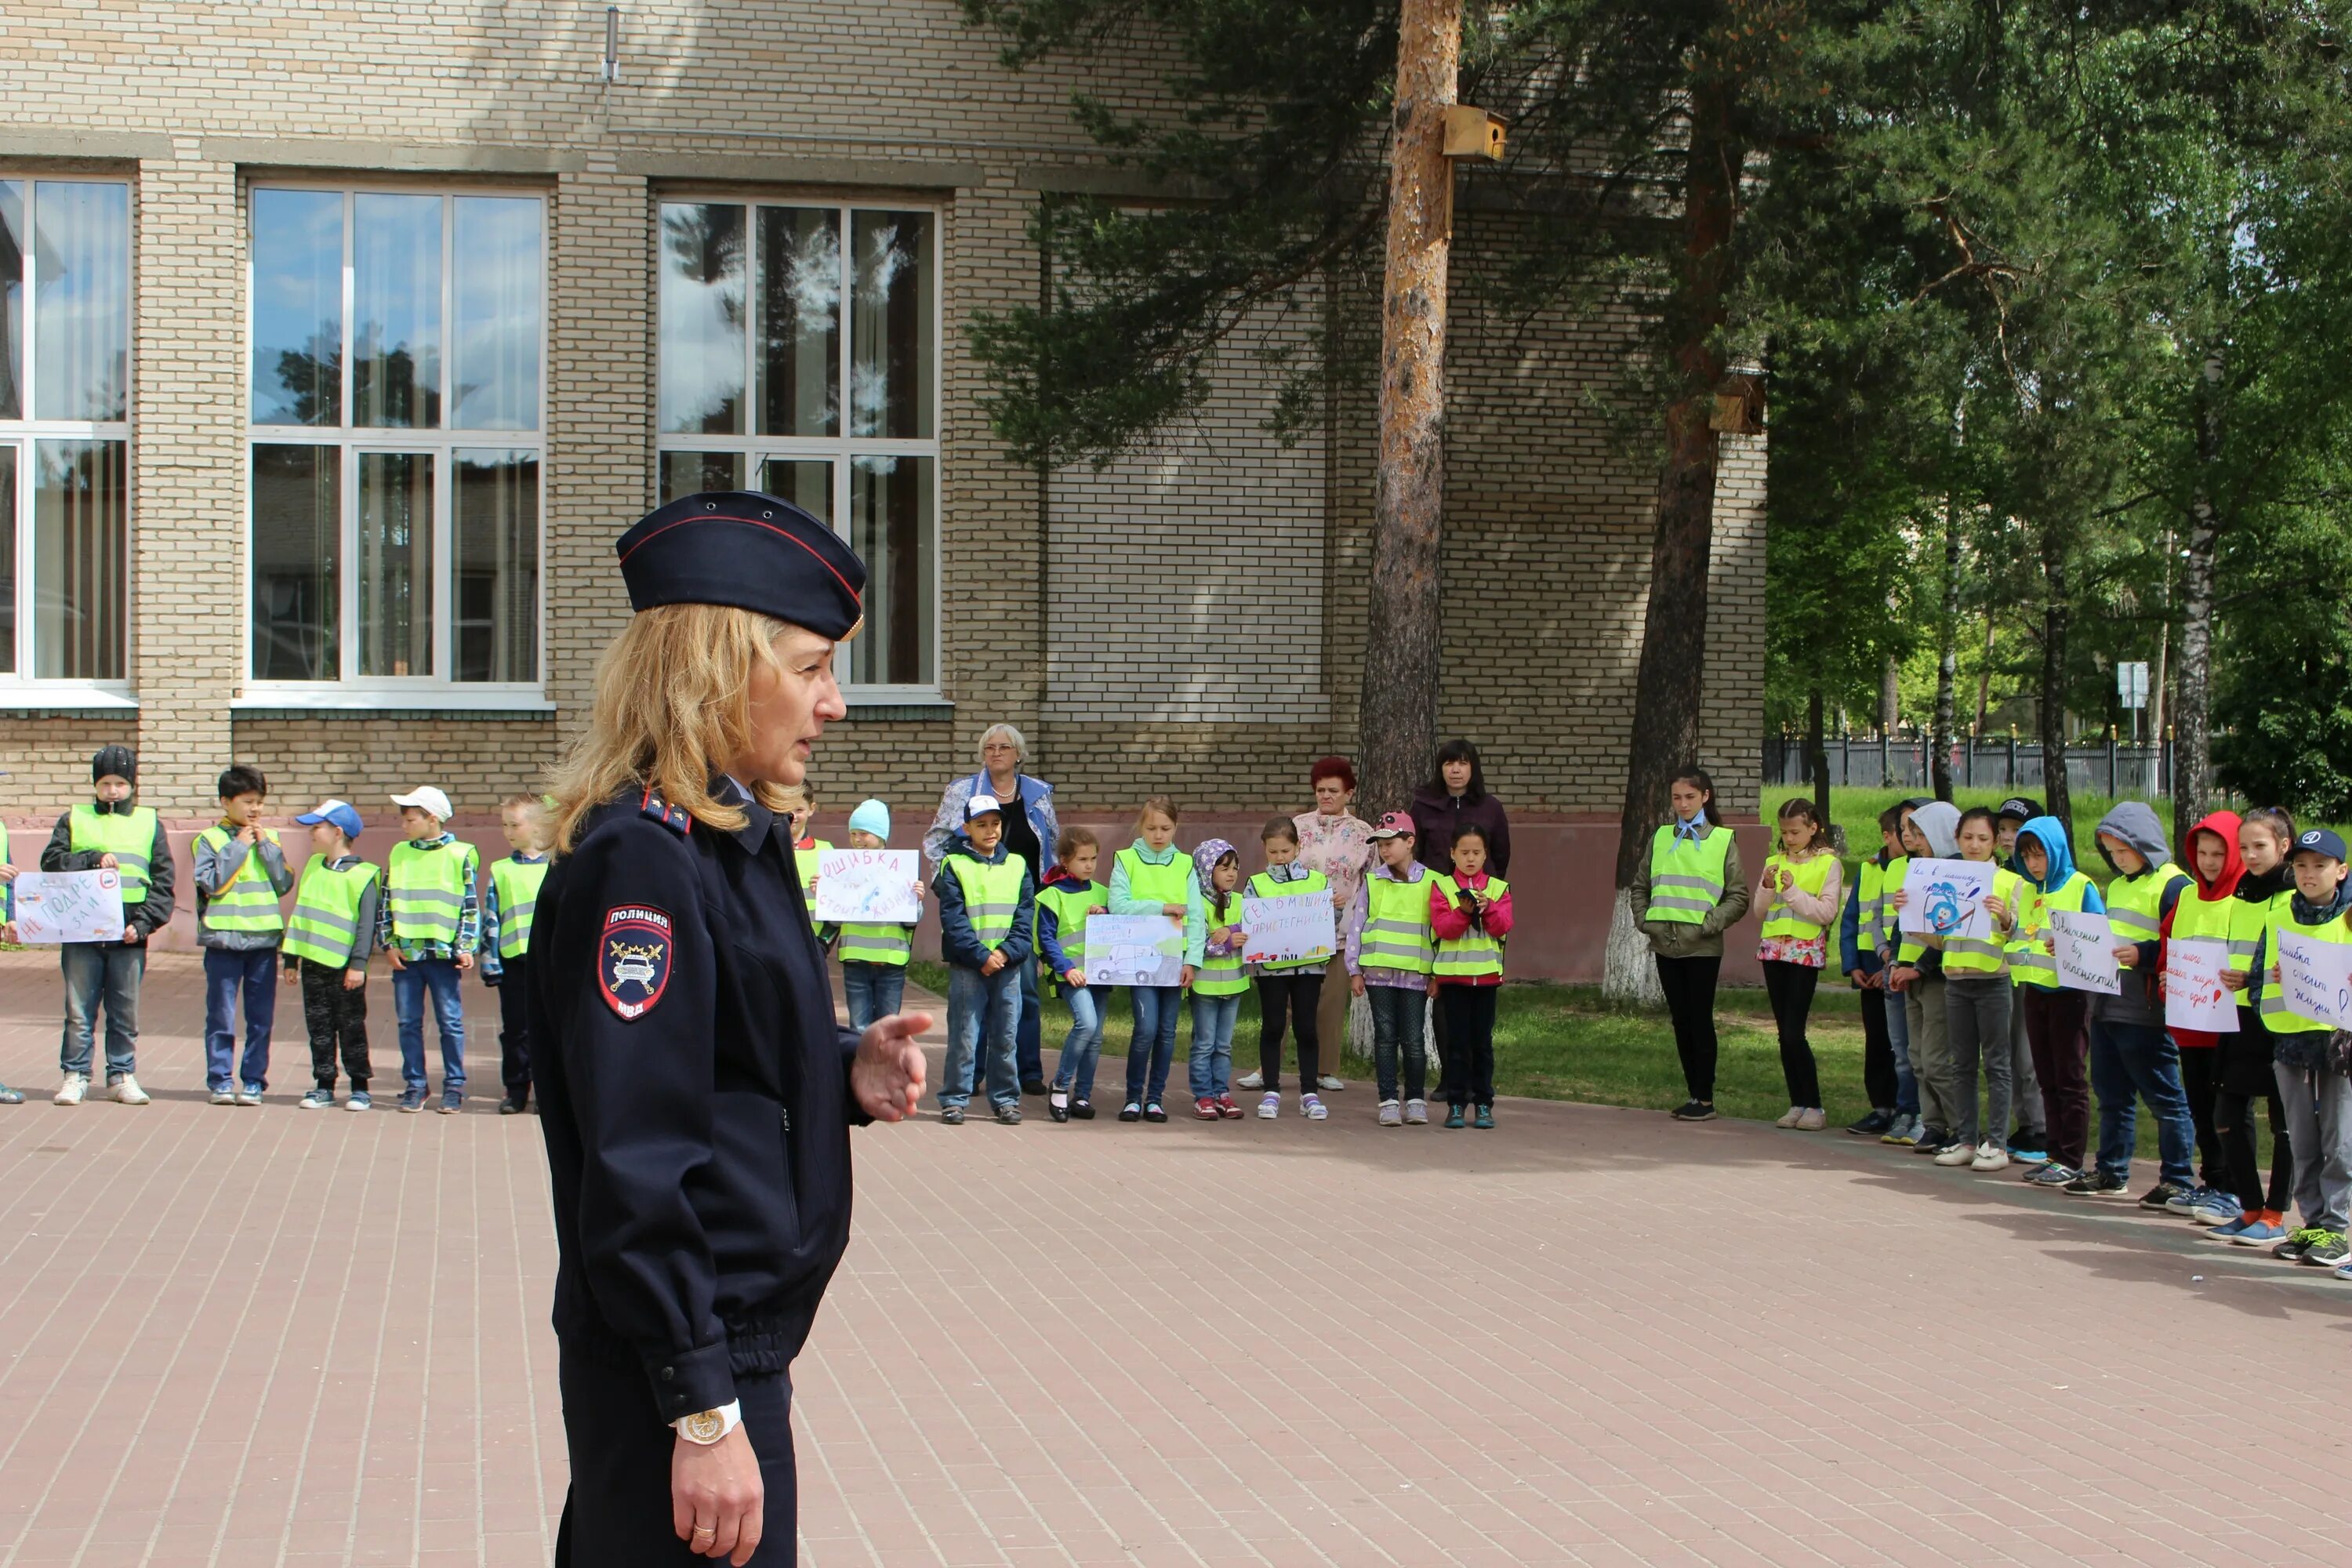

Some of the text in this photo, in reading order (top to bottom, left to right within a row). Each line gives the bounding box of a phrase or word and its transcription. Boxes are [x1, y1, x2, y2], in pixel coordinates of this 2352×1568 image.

[823, 850, 898, 878] ОШИБКА
[609, 909, 669, 929] ПОЛИЦИЯ
[1243, 902, 1270, 924] СЕЛ
[1276, 898, 1284, 909] В
[2050, 911, 2101, 944] Движение
[2277, 931, 2311, 967] Ошибка
[2292, 968, 2327, 993] стоит
[617, 1000, 644, 1018] МВД
